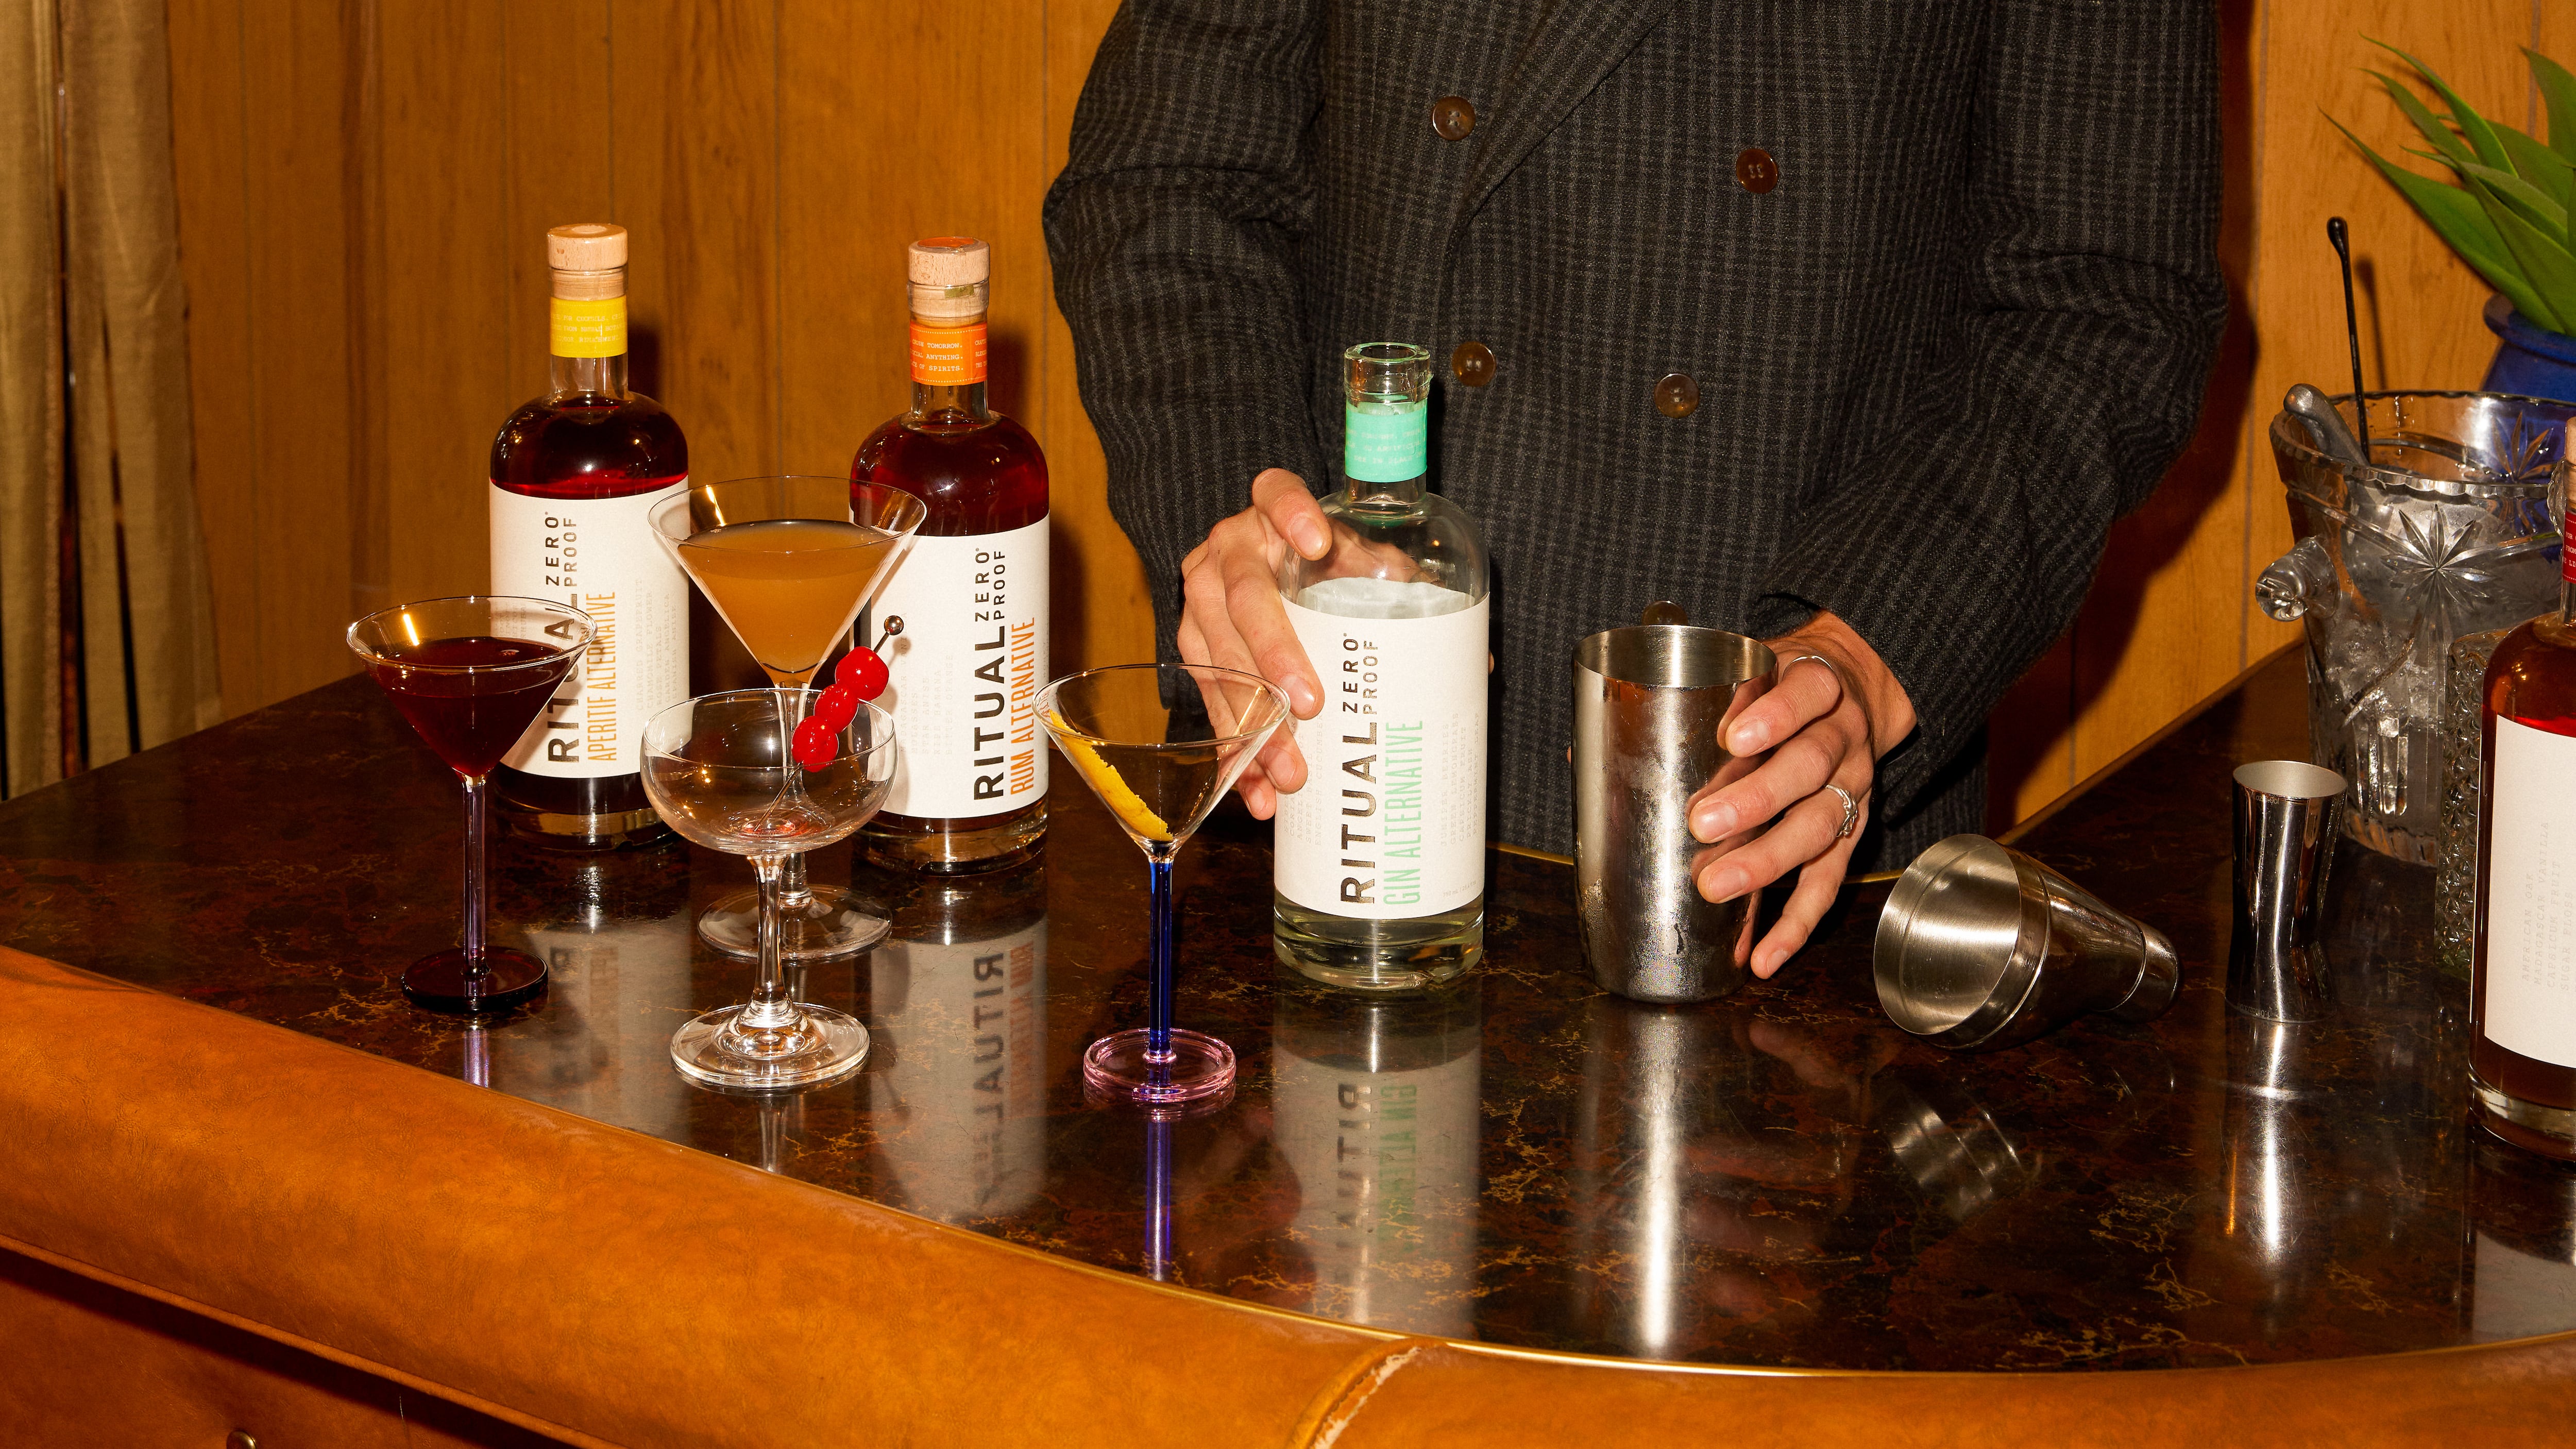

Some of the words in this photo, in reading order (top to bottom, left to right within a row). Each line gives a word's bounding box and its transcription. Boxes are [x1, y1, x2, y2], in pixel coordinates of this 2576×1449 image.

[563, 517, 578, 587] PROOF
[993, 550, 1006, 620] PROOF
[585, 591, 616, 690] ALTERNATIVE
[635, 579, 643, 652] GRAPEFRUIT
[635, 660, 643, 711] CHARRED
[1010, 617, 1035, 744] ALTERNATIVE
[1363, 639, 1378, 715] PROOF
[587, 696, 617, 762] APERITIF
[973, 625, 1005, 801] RITUAL
[1010, 749, 1034, 795] RUM
[1384, 721, 1422, 858] ALTERNATIVE
[1340, 722, 1377, 904] RITUAL
[1382, 868, 1421, 905] GIN
[2525, 872, 2534, 899] OAK
[2538, 821, 2548, 884] VANILLA
[2550, 861, 2561, 906] FRUIT
[2522, 909, 2532, 982] AMERICAN
[2534, 895, 2546, 986] MADAGASCAR
[2563, 891, 2573, 937] FLOSS
[2547, 916, 2558, 988] CAPSICUM
[2561, 947, 2571, 991] SUGAR
